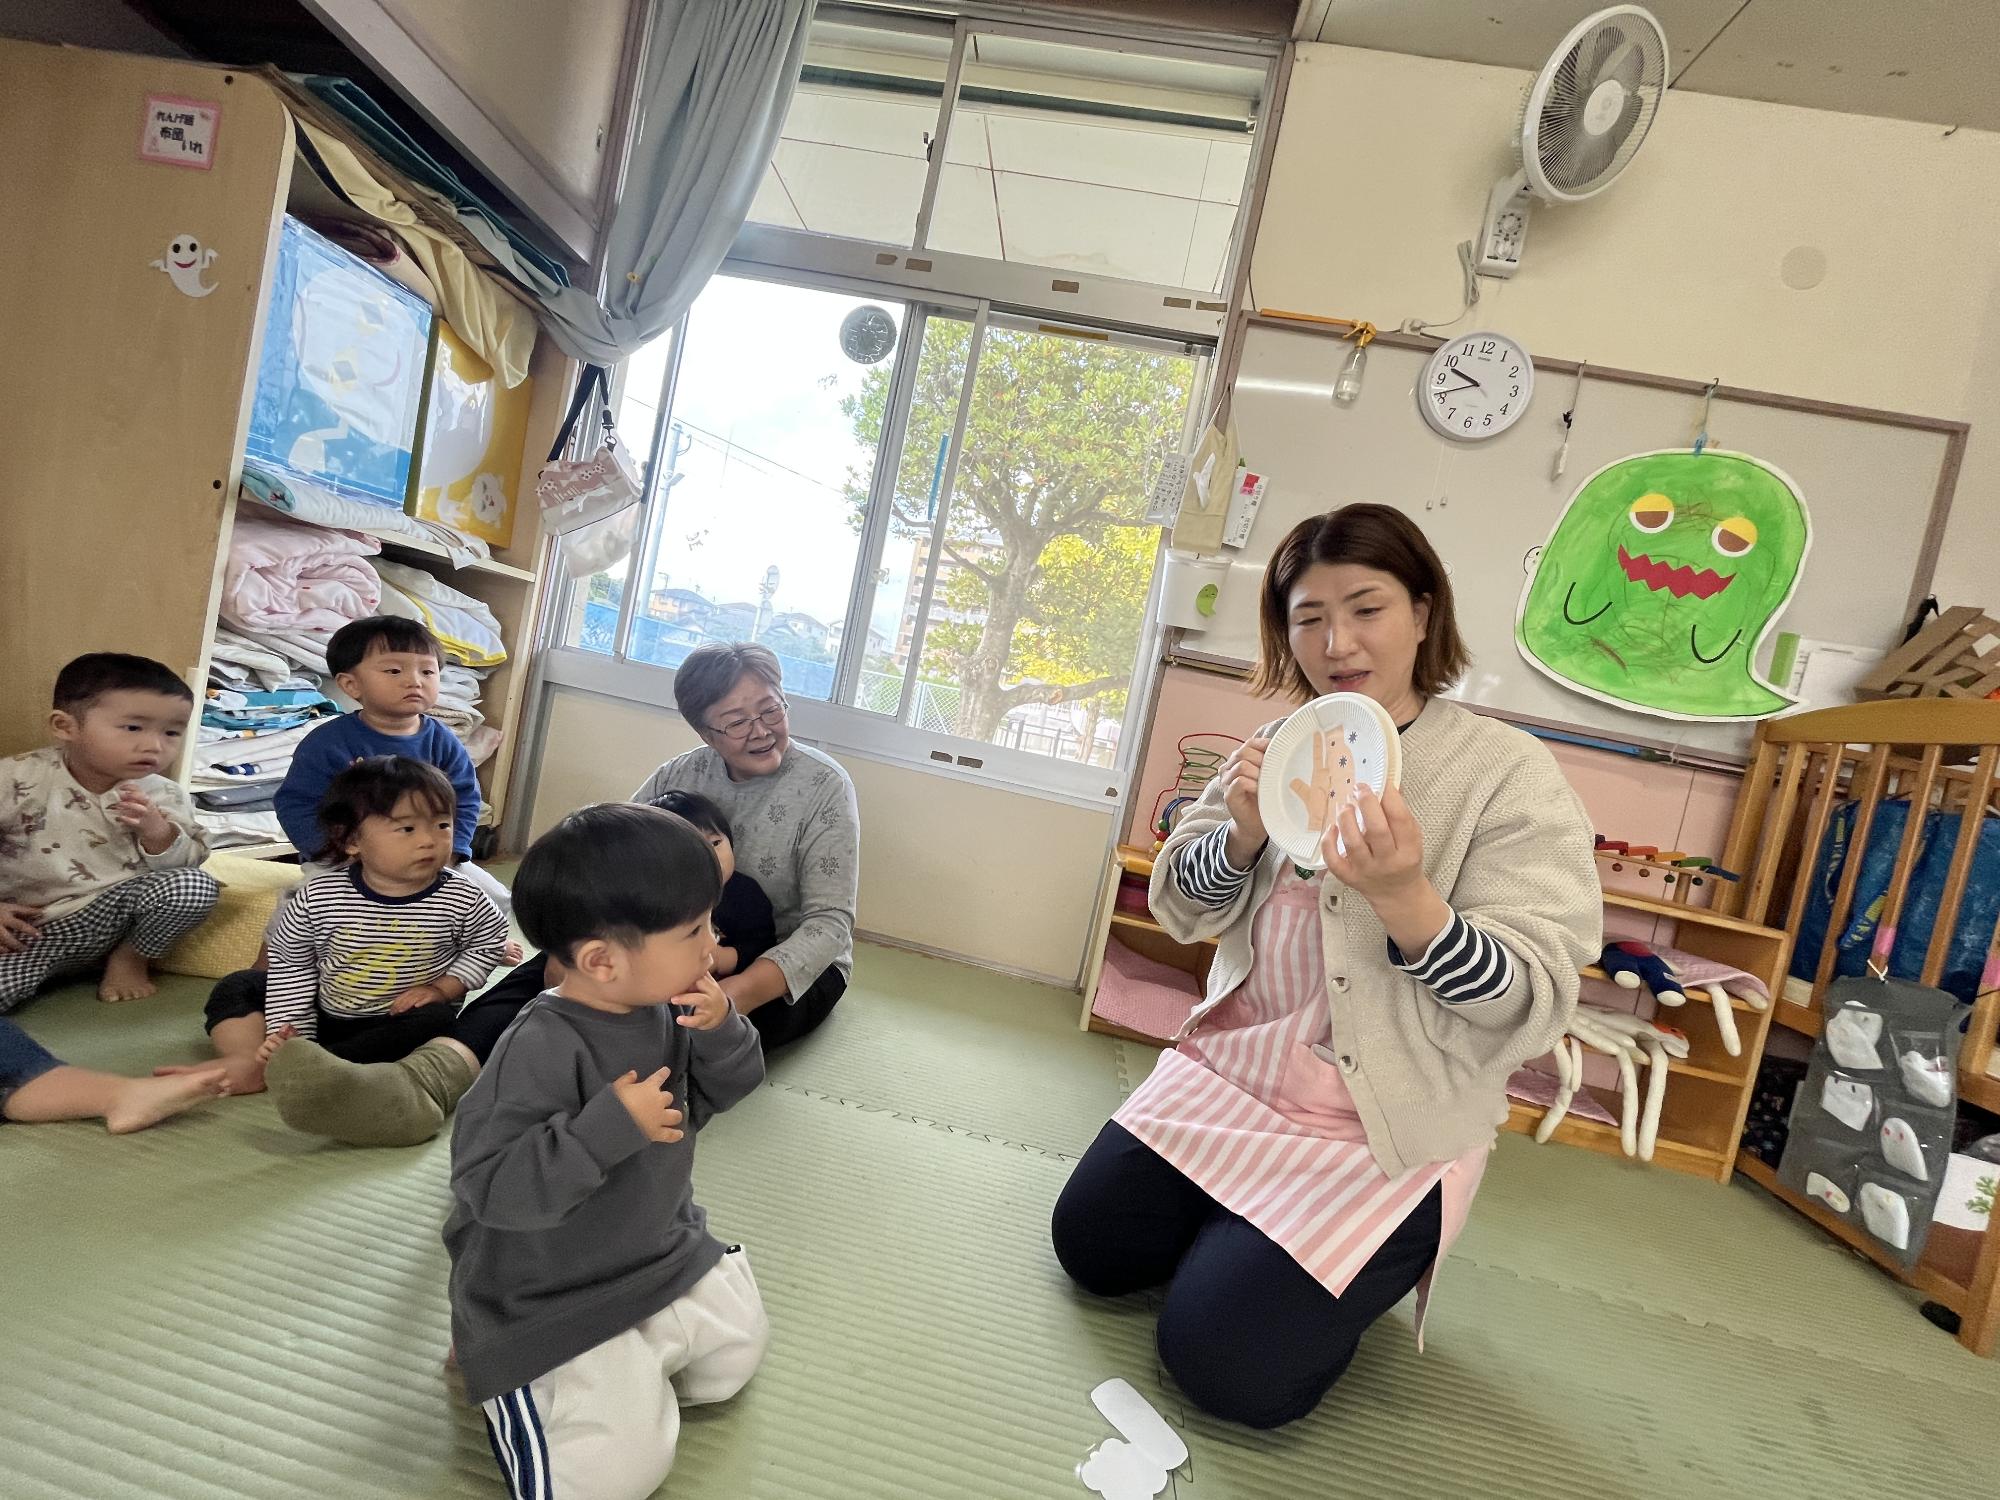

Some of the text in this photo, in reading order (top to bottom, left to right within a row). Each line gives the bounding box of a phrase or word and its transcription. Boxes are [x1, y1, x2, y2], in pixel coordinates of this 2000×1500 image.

[182, 140, 202, 154] いれ
[1461, 344, 1475, 356] 11
[1480, 341, 1496, 354] 12
[1444, 355, 1459, 368] 10
[1500, 350, 1508, 362] 1
[1509, 366, 1519, 378] 2
[1436, 373, 1446, 385] 9
[1509, 385, 1519, 397] 3
[1437, 392, 1447, 404] 8
[1447, 407, 1457, 419] 7
[1500, 403, 1509, 415] 4
[1463, 416, 1474, 428] 6
[1483, 414, 1494, 426] 5
